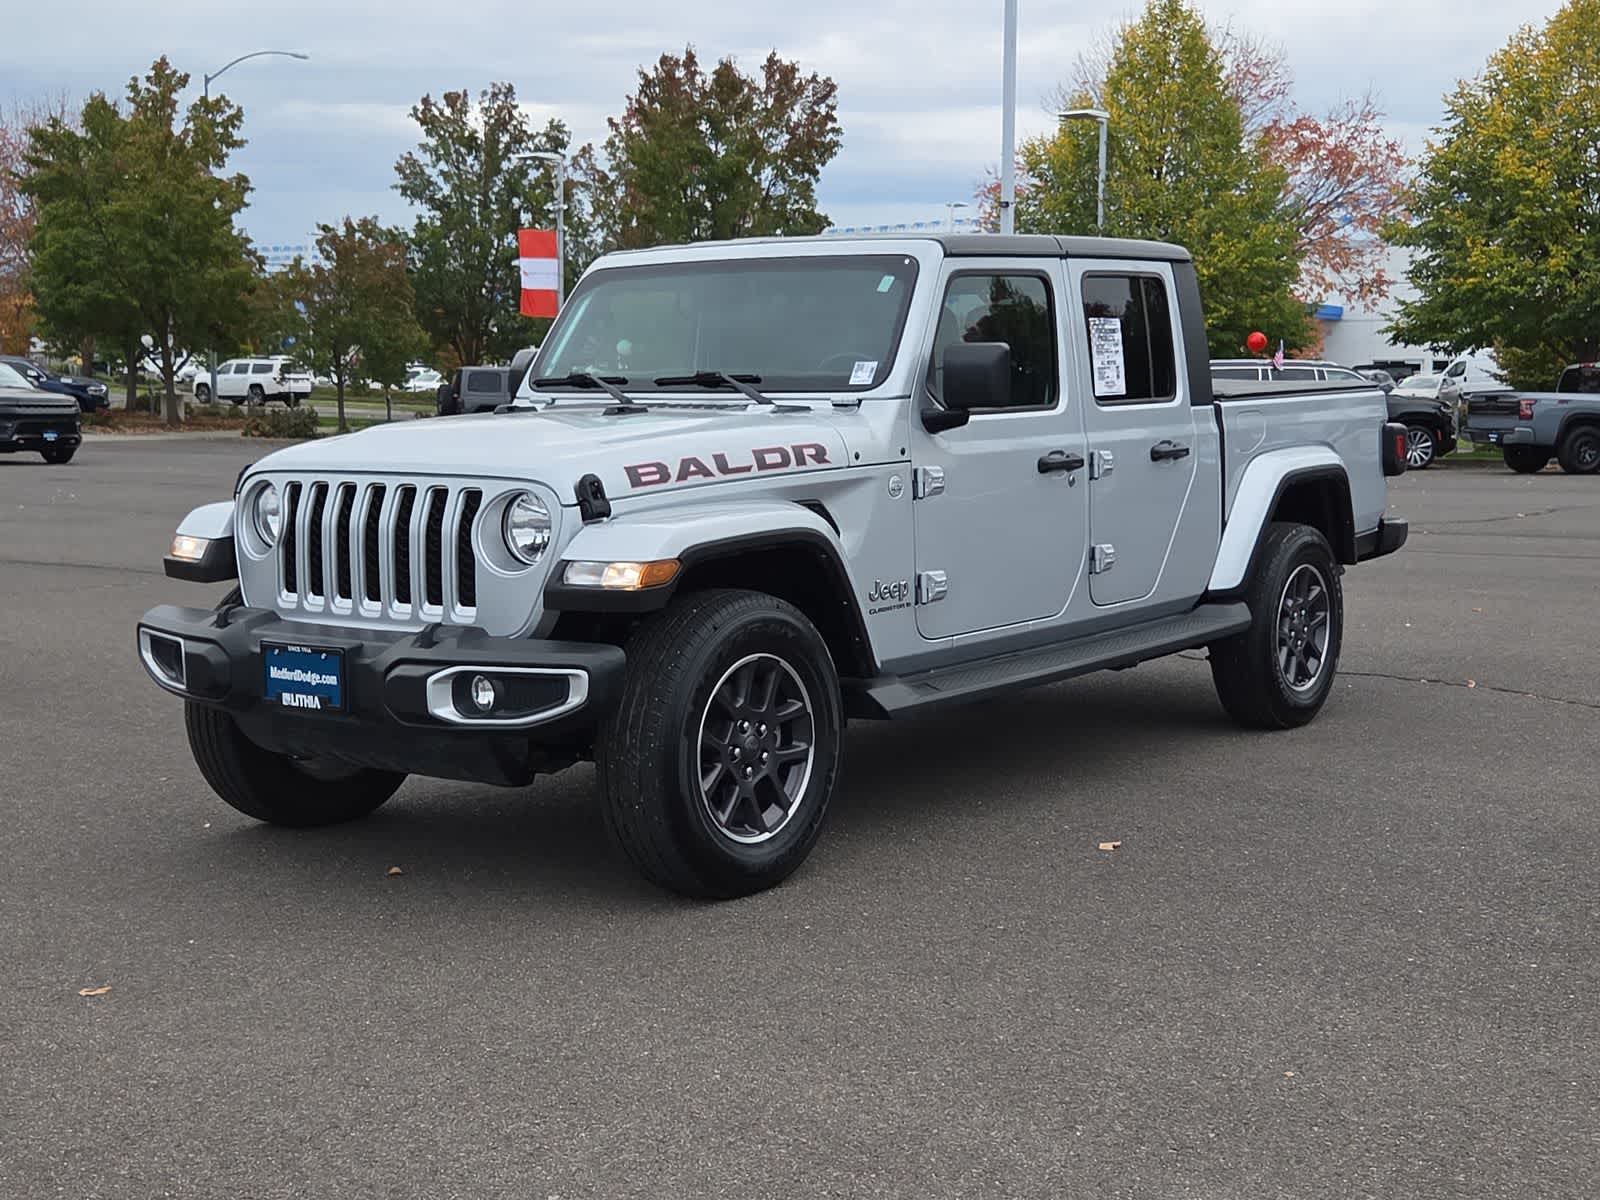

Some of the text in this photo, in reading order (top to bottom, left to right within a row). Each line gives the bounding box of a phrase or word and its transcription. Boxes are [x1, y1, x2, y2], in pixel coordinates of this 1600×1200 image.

[624, 443, 832, 488] BALDR
[868, 579, 909, 602] Jeep
[269, 665, 338, 686] MedfordDodge.com
